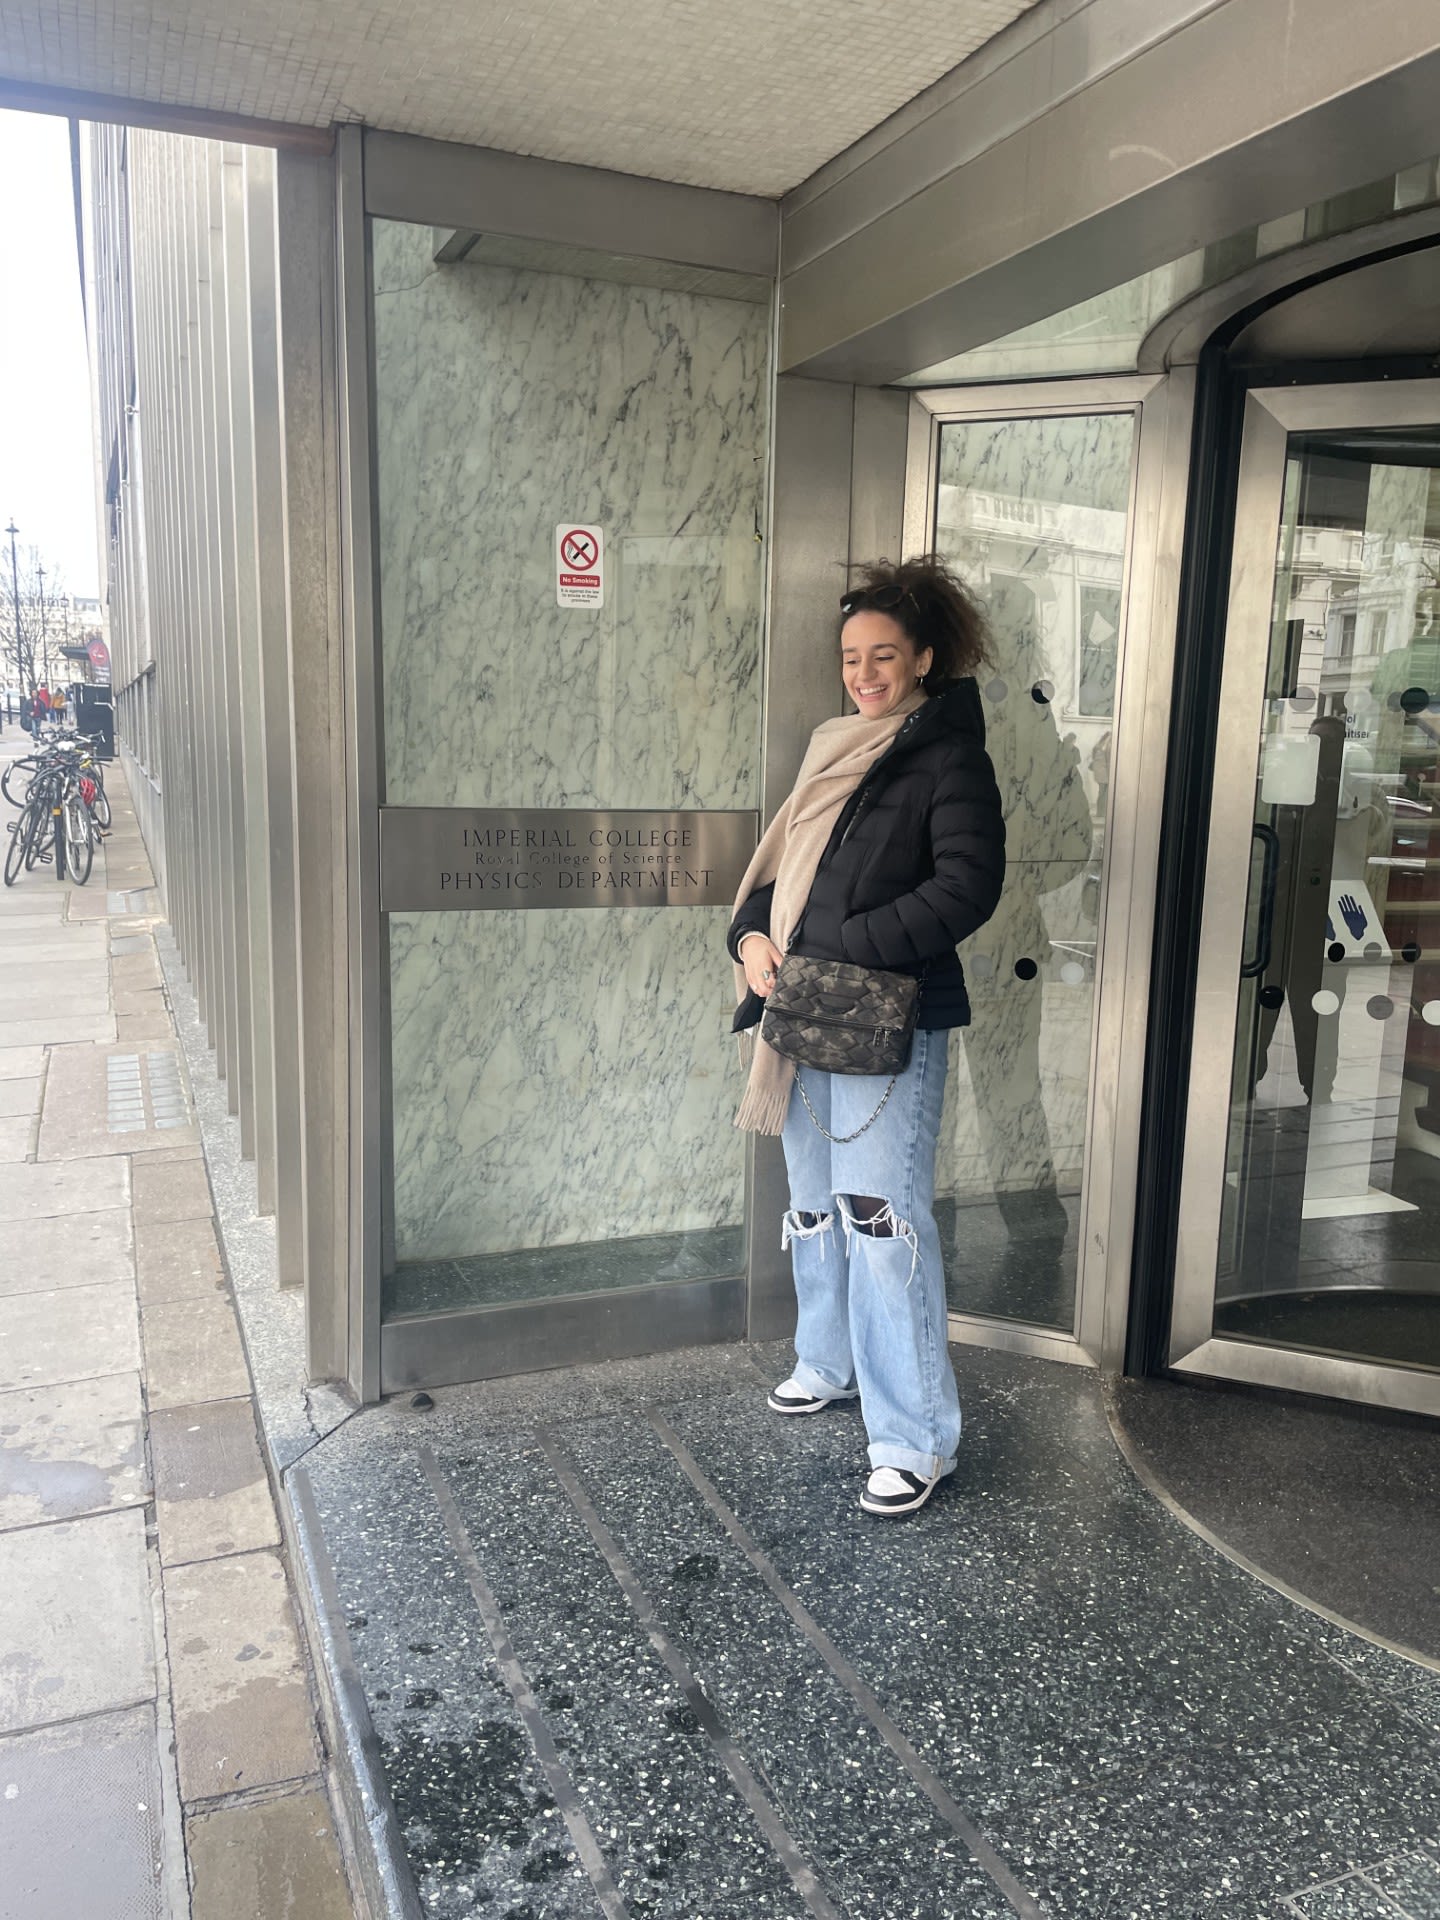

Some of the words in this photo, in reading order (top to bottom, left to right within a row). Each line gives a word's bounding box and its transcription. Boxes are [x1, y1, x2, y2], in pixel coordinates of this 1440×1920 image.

[573, 577, 598, 586] Smoking
[463, 829, 577, 848] IMPERIAL
[589, 829, 693, 848] COLLEGE
[475, 851, 520, 866] Royal
[528, 851, 590, 869] College
[598, 851, 615, 865] of
[623, 851, 682, 865] Science
[440, 871, 543, 890] PHYSICS
[558, 869, 714, 889] DEPARTMENT
